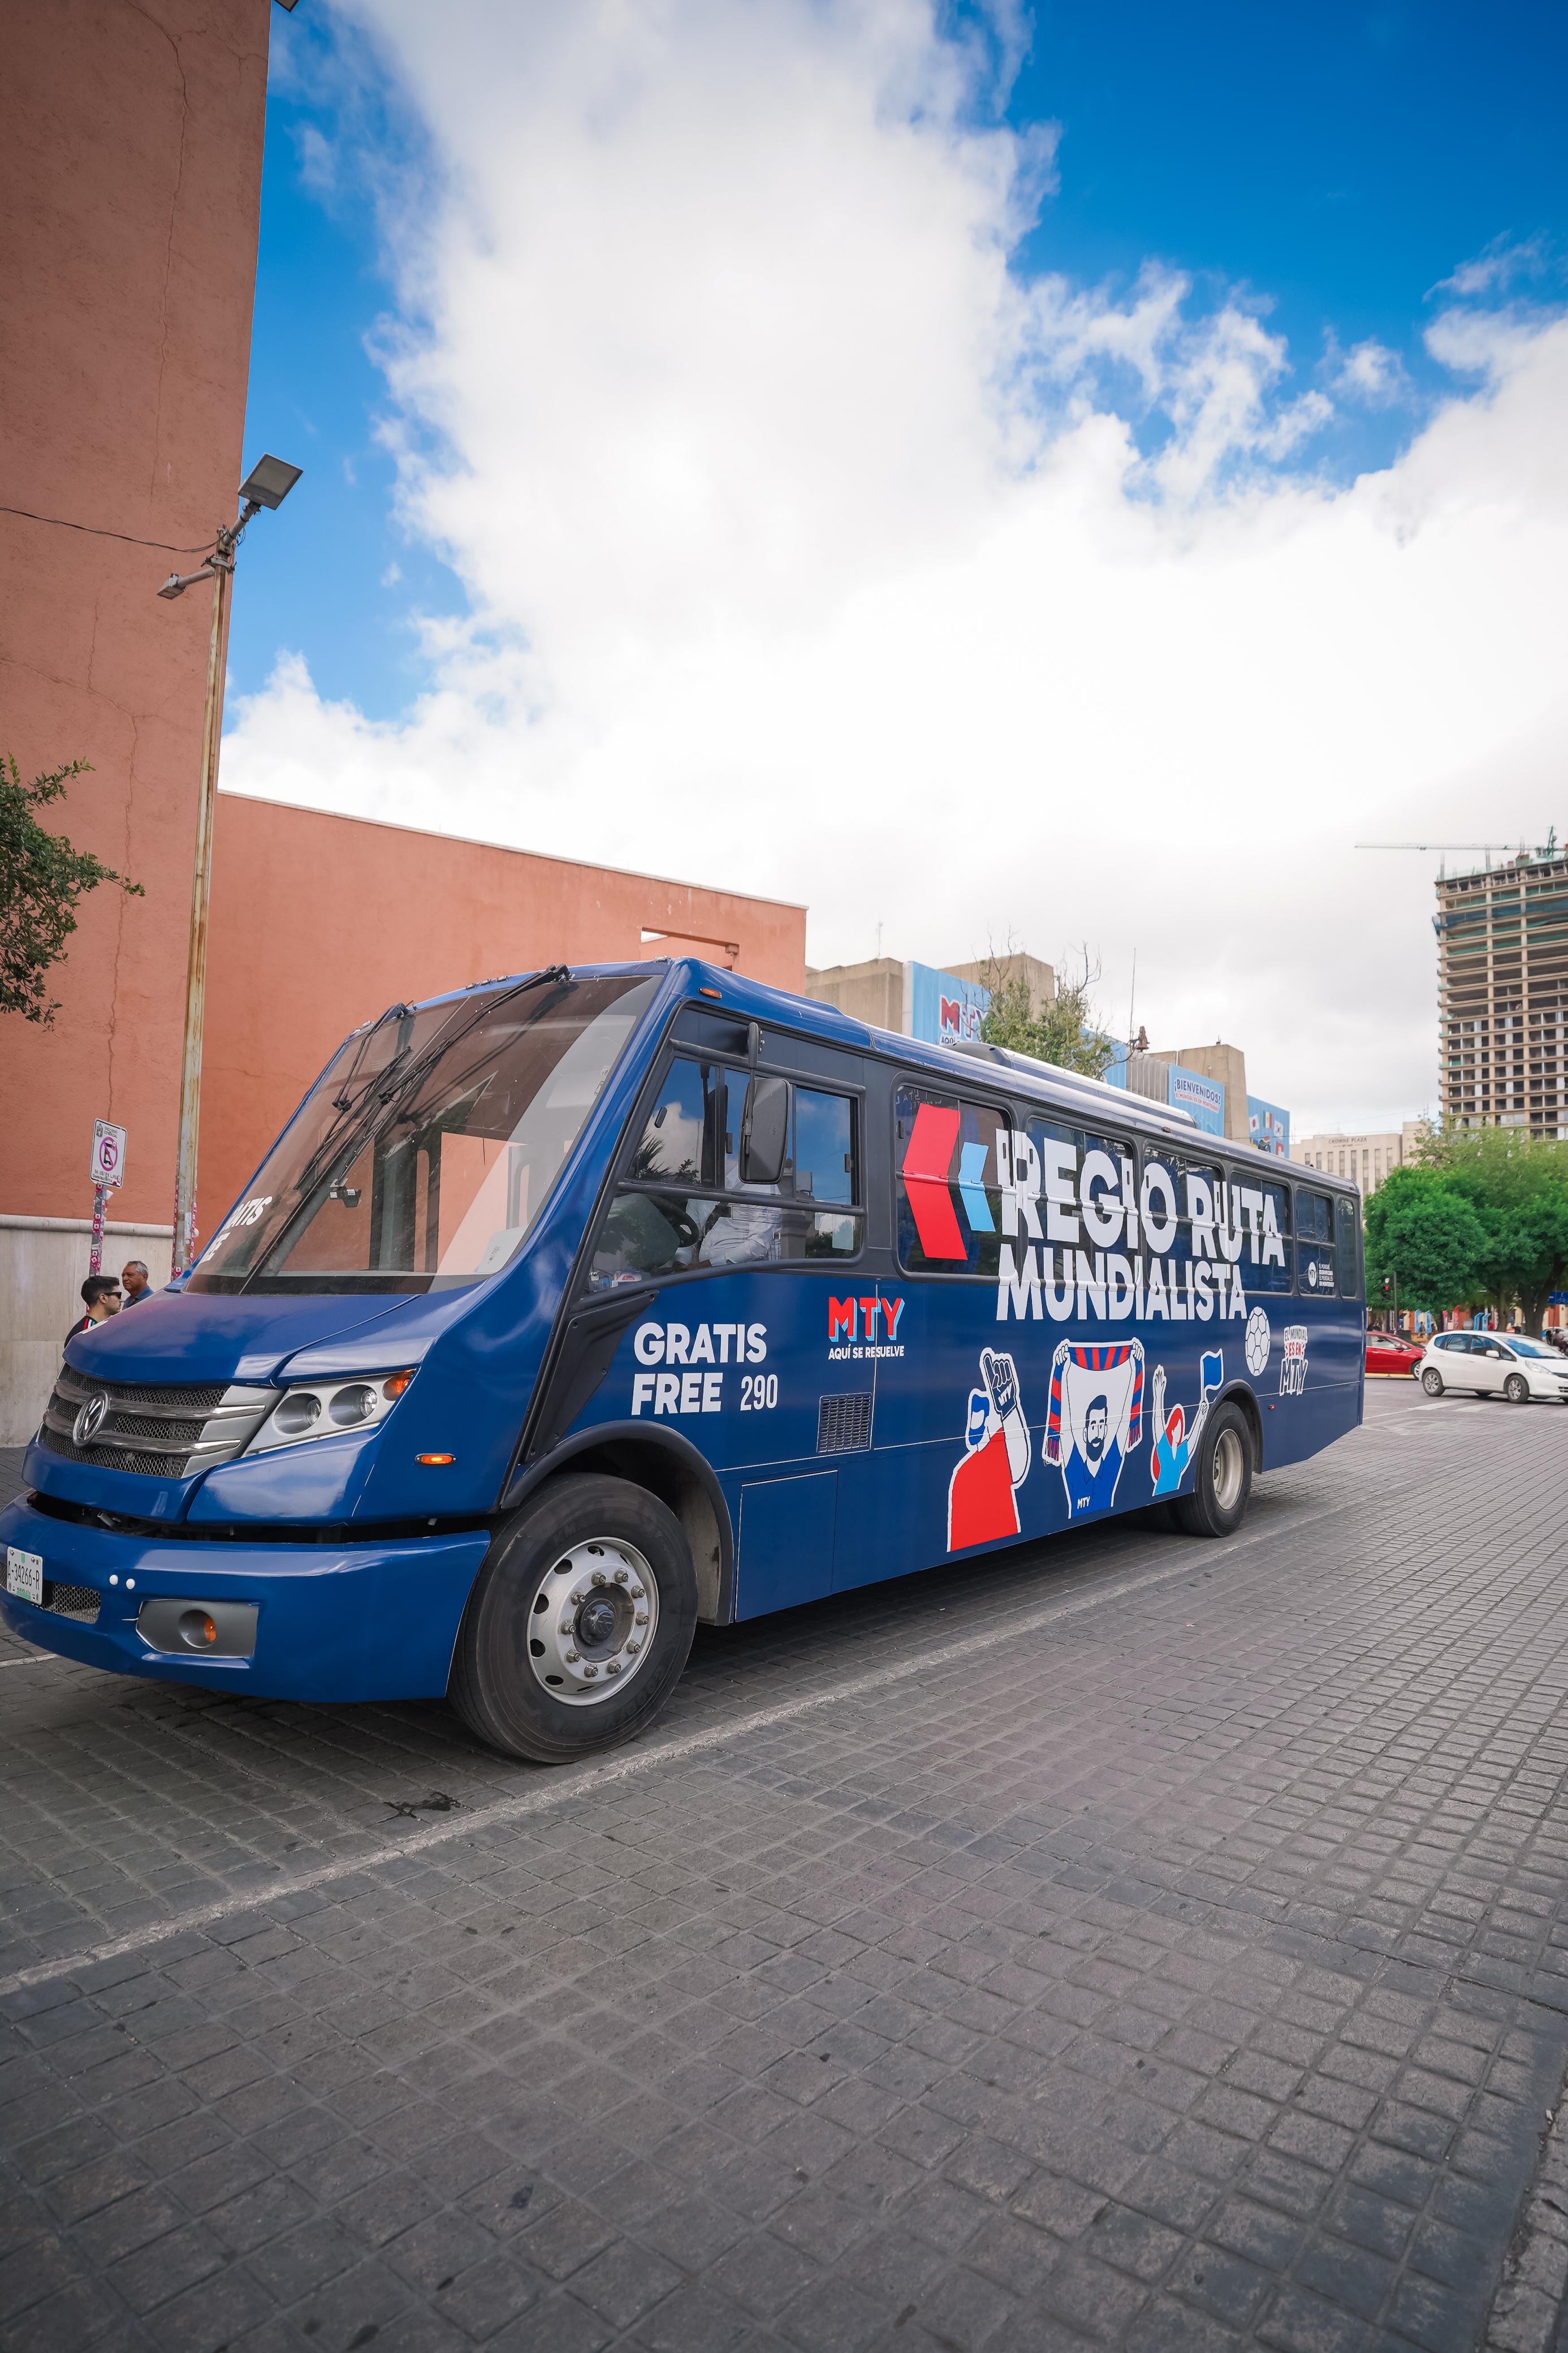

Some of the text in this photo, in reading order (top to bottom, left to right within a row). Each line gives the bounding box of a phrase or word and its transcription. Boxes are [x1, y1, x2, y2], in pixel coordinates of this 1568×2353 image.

[1174, 1079, 1221, 1105] ¡BIENVENIDOS!
[996, 1128, 1285, 1267] REGIO RUTA
[996, 1243, 1247, 1322] MUNDIALISTA
[828, 1297, 905, 1342] MTY
[1285, 1328, 1307, 1342] EL MUNDIAL
[634, 1322, 767, 1365] GRATIS
[828, 1343, 904, 1360] AQUÍ SE RESUELVE
[1289, 1342, 1301, 1357] ES EN
[1280, 1358, 1308, 1397] MTY
[632, 1373, 778, 1415] FREE 290
[998, 1382, 1012, 1406] MTY
[1077, 1496, 1090, 1509] MTY
